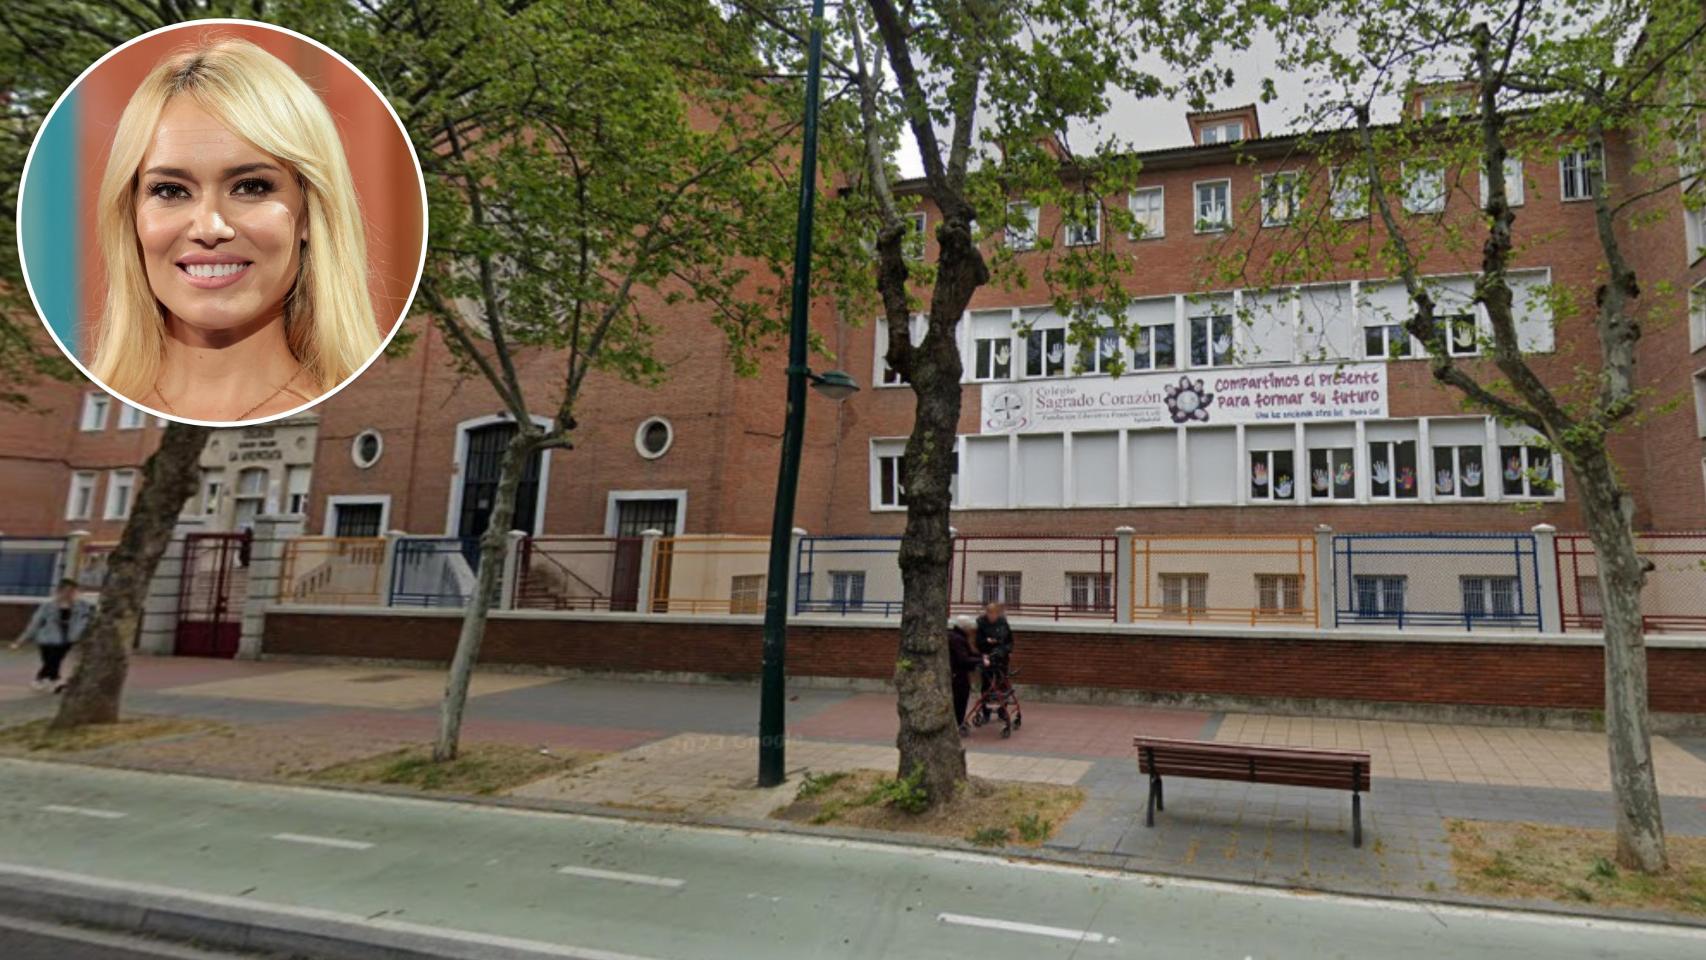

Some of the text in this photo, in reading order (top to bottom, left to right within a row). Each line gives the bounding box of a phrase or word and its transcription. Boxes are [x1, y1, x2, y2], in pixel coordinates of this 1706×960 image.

[1304, 374, 1315, 387] el
[1036, 385, 1076, 397] Colegio
[1255, 392, 1303, 407] formar
[1310, 391, 1326, 405] su
[1332, 389, 1379, 405] futuro
[1036, 393, 1094, 409] Sagrado
[1099, 389, 1161, 406] Corazón
